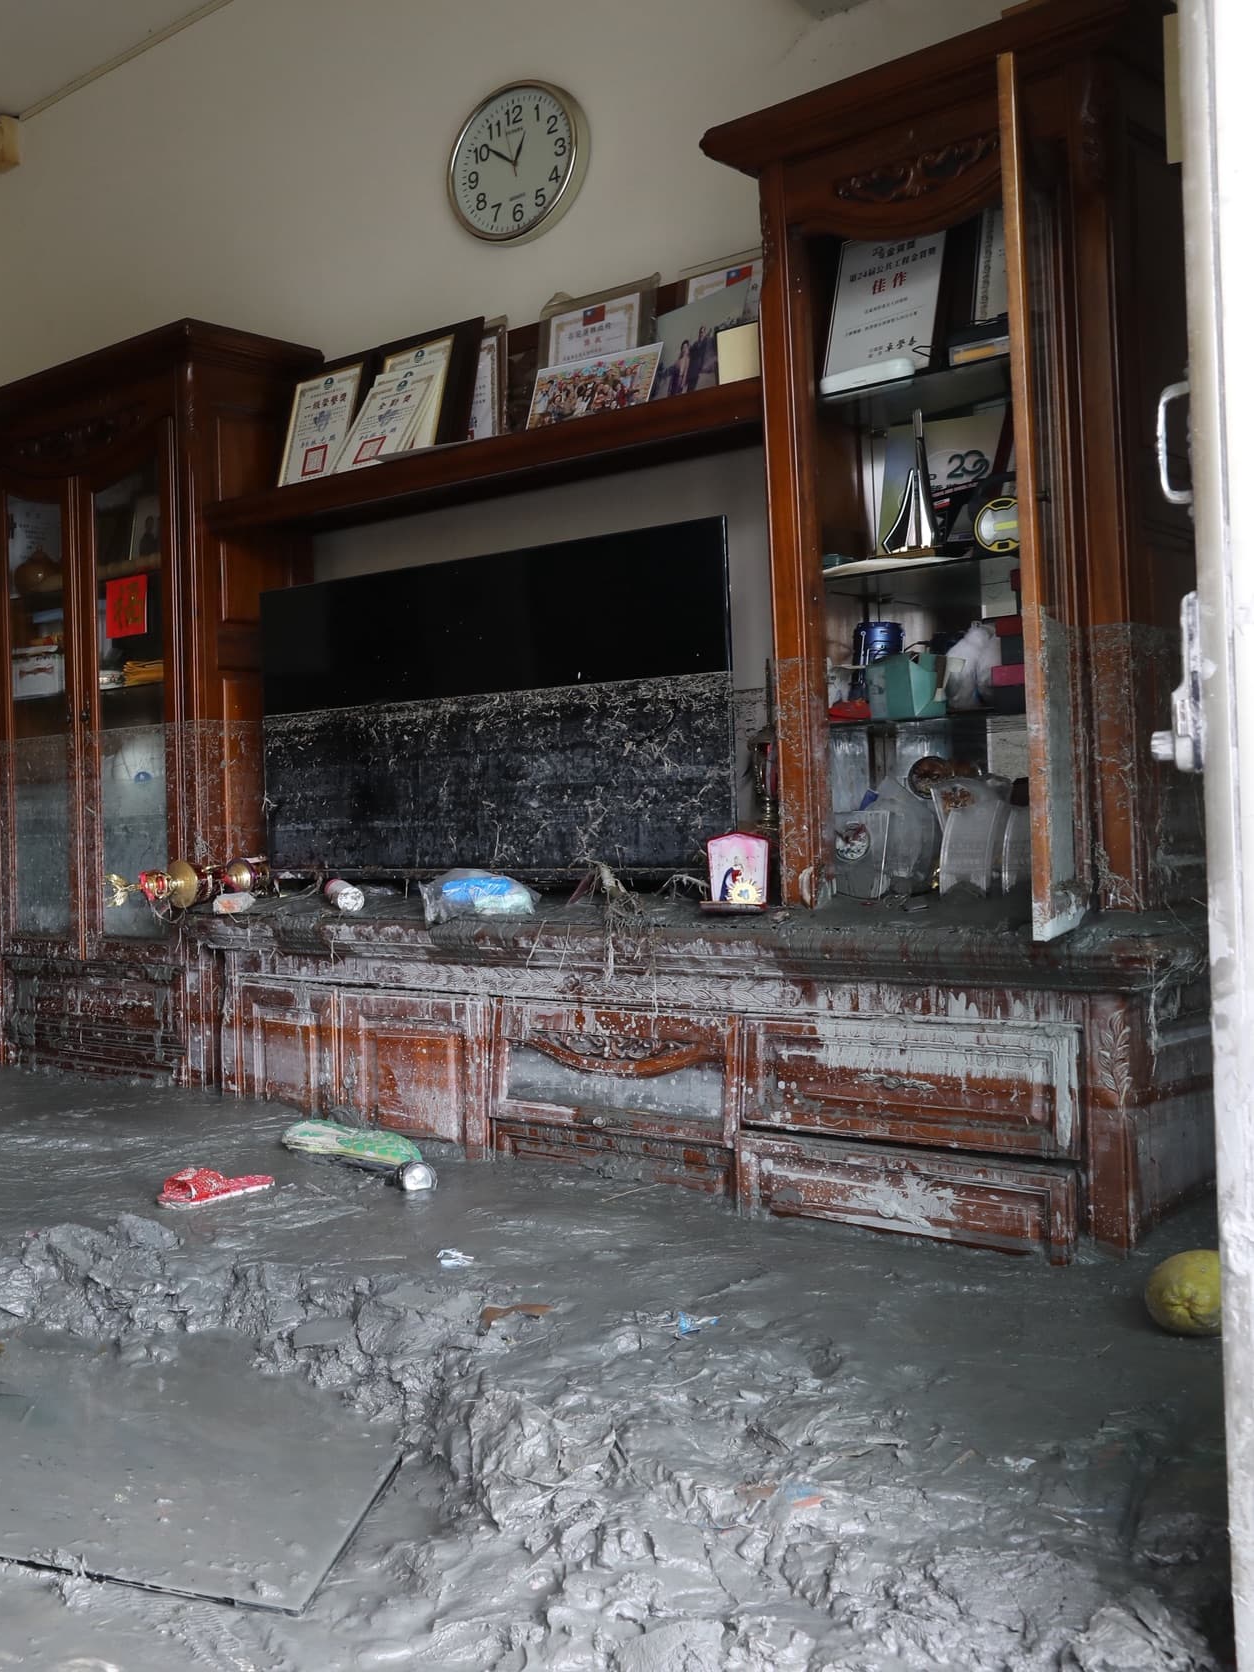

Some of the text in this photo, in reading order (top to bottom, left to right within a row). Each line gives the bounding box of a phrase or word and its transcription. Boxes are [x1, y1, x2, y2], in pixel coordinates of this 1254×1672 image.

[505, 104, 523, 127] 12
[534, 103, 540, 122] 1
[487, 120, 501, 141] 11
[546, 115, 558, 135] 2
[474, 143, 490, 165] 10
[554, 137, 567, 157] 3
[468, 171, 479, 190] 9
[548, 165, 561, 184] 4
[476, 192, 487, 211] 8
[534, 187, 546, 207] 5
[491, 203, 502, 223] 7
[512, 203, 524, 222] 6
[872, 271, 908, 296] 佳作
